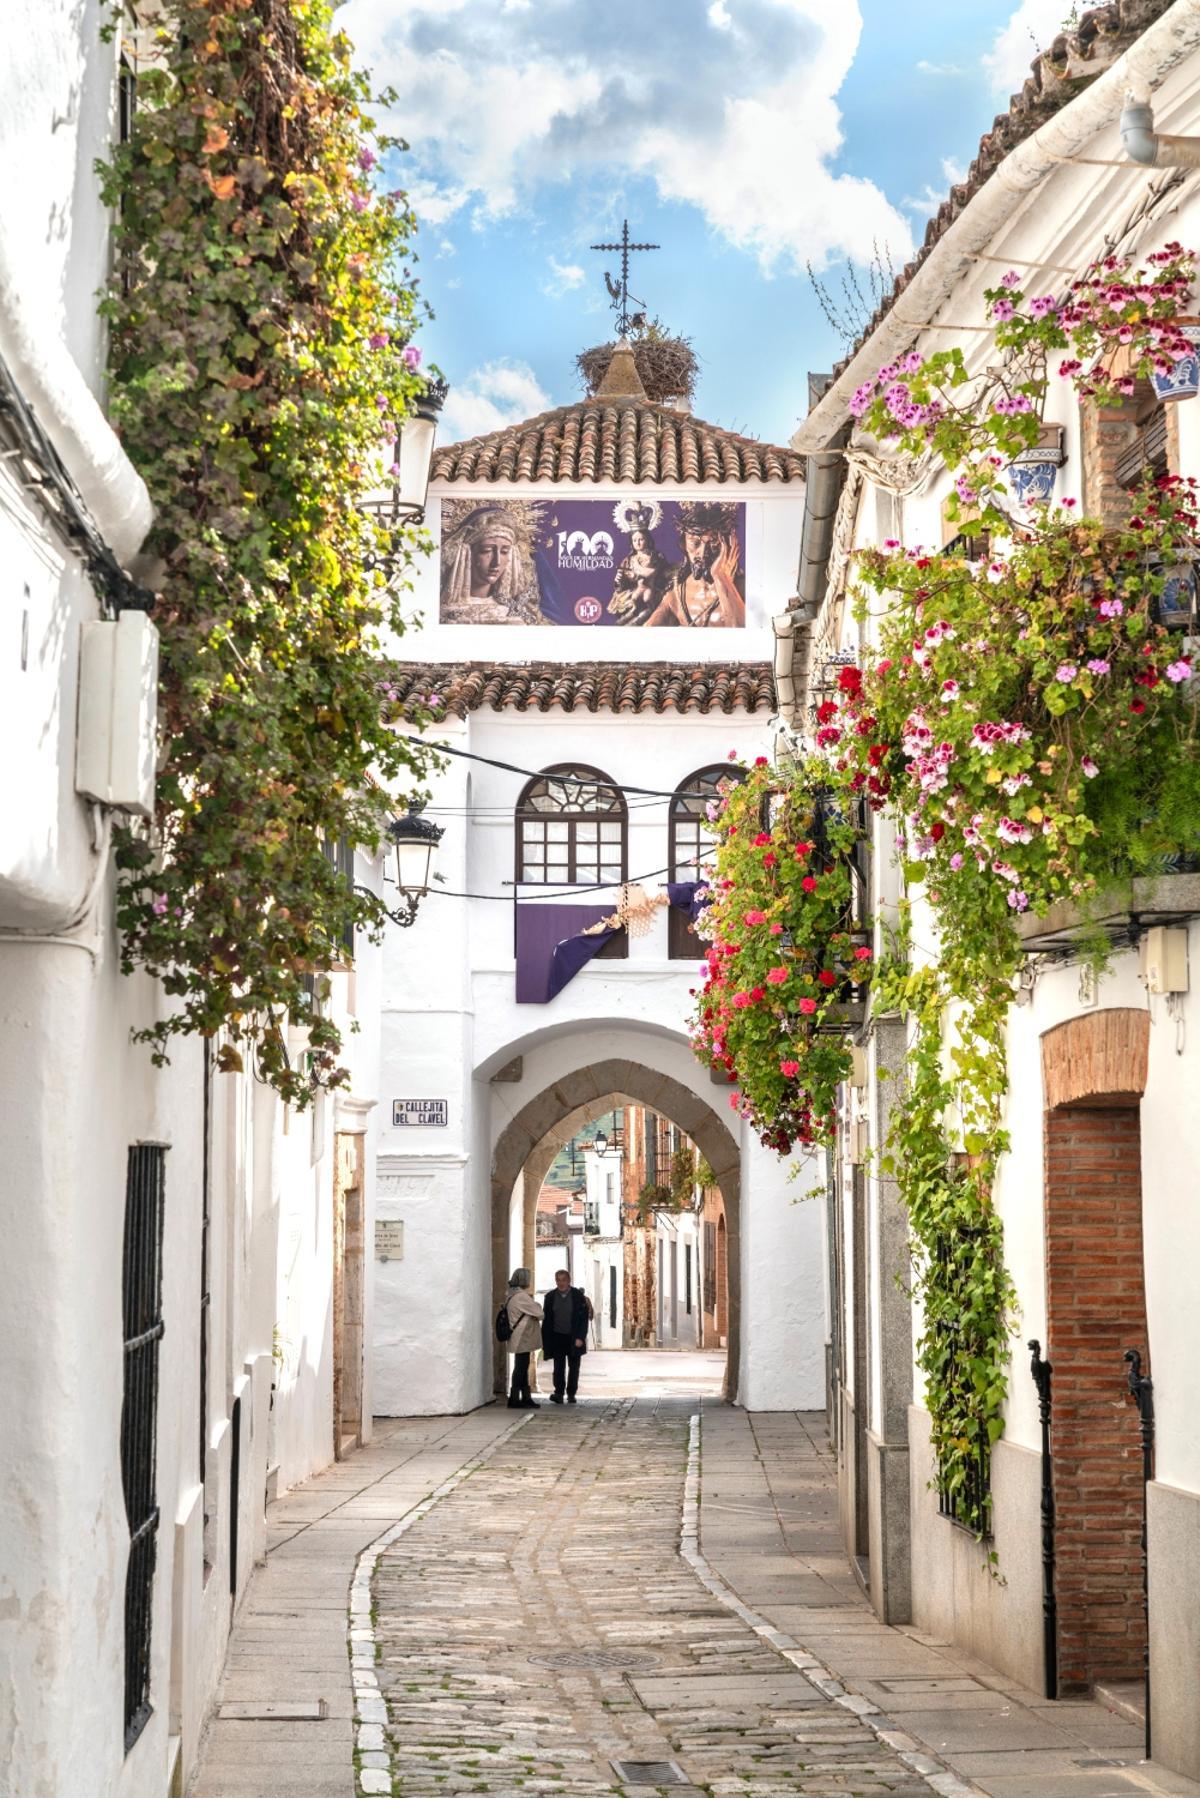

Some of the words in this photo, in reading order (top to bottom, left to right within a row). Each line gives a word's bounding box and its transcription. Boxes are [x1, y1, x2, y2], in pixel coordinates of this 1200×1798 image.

[556, 530, 614, 557] 100
[557, 559, 614, 569] HUMILDAD
[405, 1102, 443, 1112] CALLEJITA
[395, 1113, 409, 1124] DEL
[418, 1113, 445, 1124] CLAVEL
